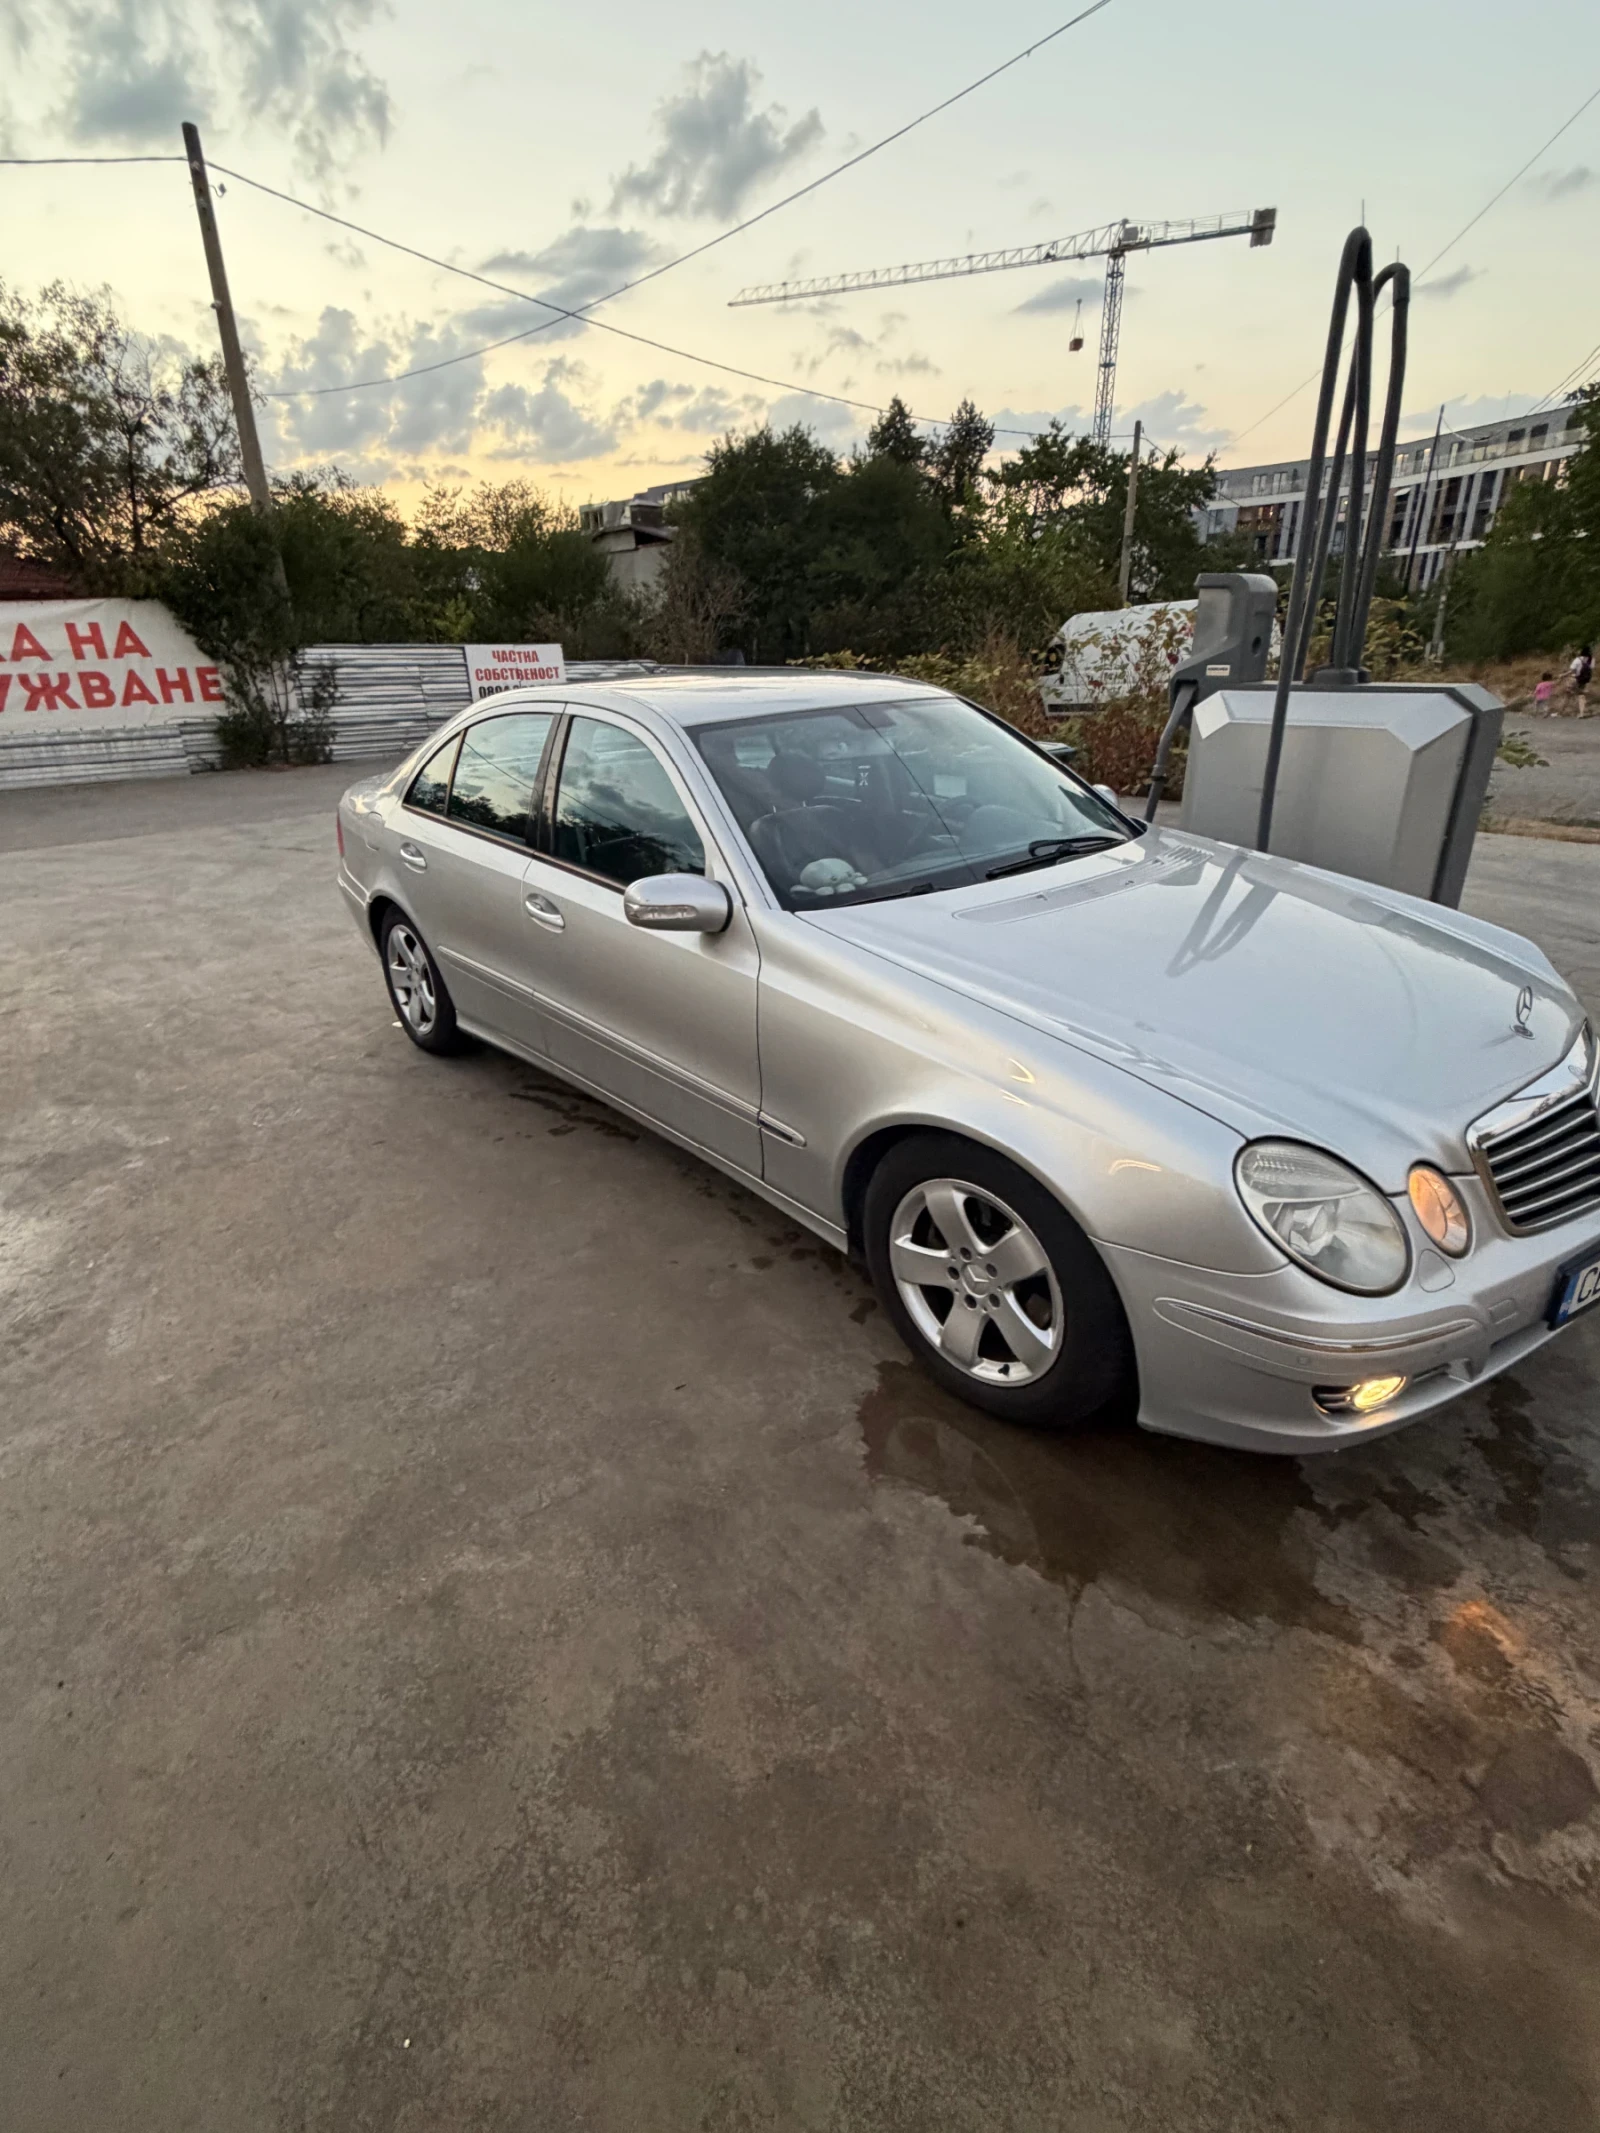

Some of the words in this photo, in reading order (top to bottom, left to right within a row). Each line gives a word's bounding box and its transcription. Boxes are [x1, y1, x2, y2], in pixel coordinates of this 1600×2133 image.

[0, 622, 54, 662] А
[64, 620, 152, 660] НА
[492, 650, 540, 663] ЧАСТНА
[475, 666, 560, 681] СОБСТВЕНОСТ
